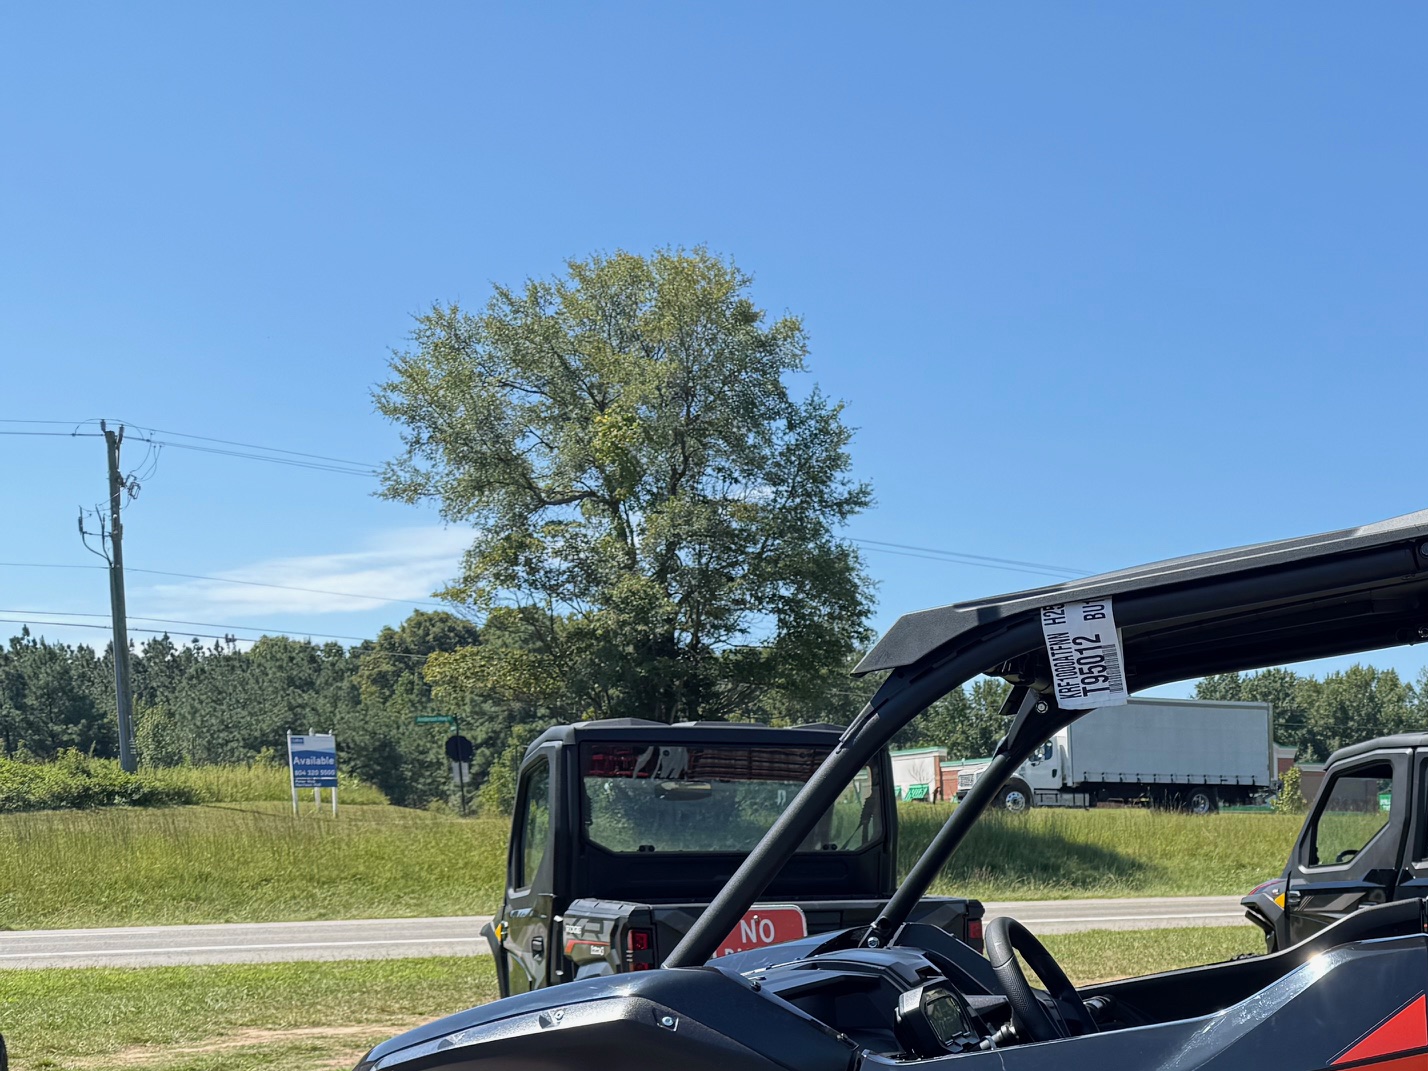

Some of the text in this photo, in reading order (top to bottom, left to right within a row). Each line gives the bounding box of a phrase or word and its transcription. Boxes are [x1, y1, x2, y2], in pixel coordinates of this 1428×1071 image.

[1072, 633, 1110, 697] T95012
[293, 756, 335, 765] Available
[740, 918, 775, 943] NO
